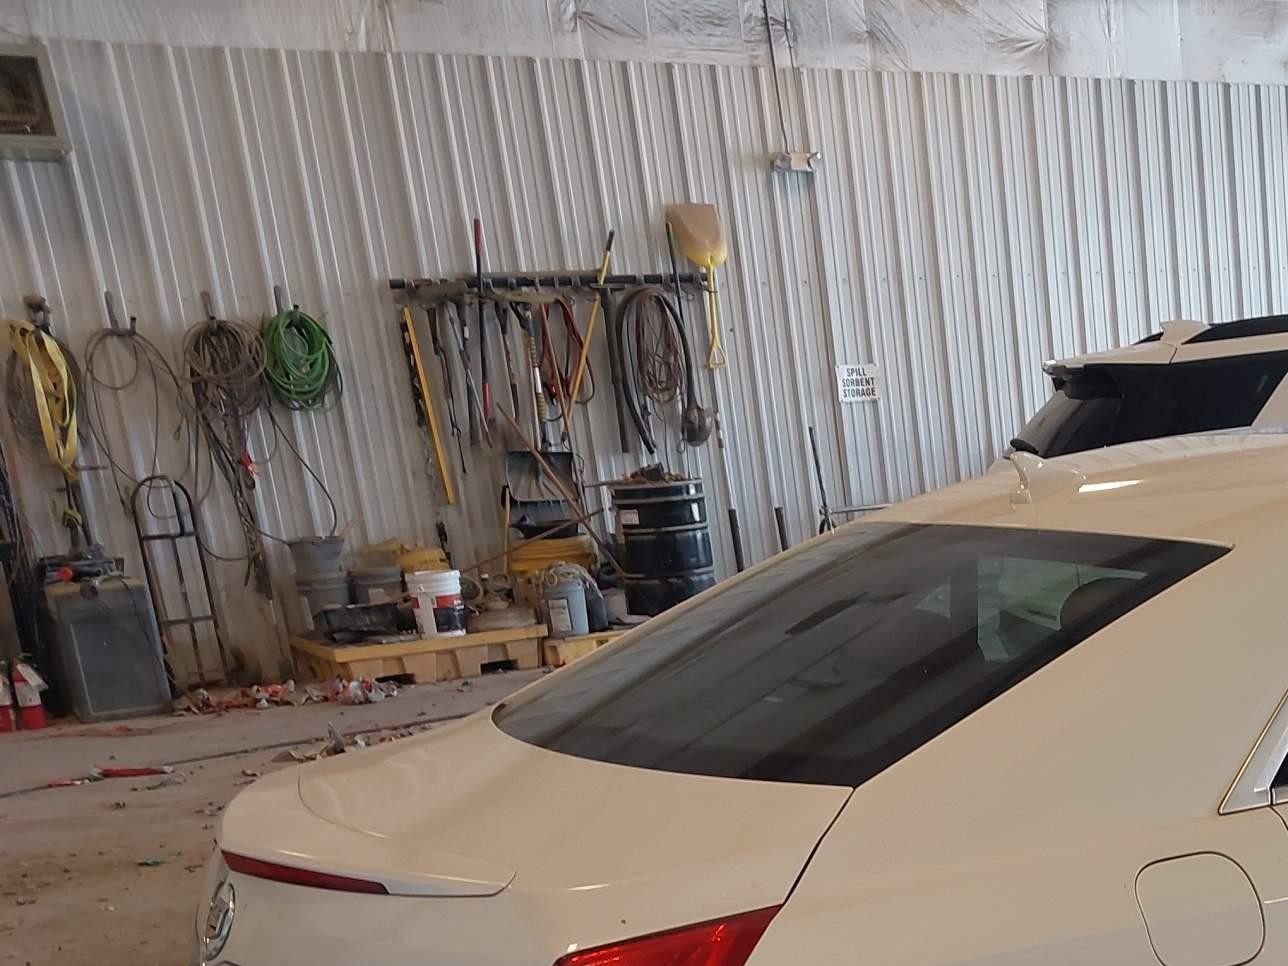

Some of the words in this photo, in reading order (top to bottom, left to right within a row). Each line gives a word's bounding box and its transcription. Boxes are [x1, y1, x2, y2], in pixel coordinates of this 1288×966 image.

[846, 367, 867, 377] SPILL
[842, 377, 875, 388] SORBENT
[843, 387, 876, 398] STORAGE
